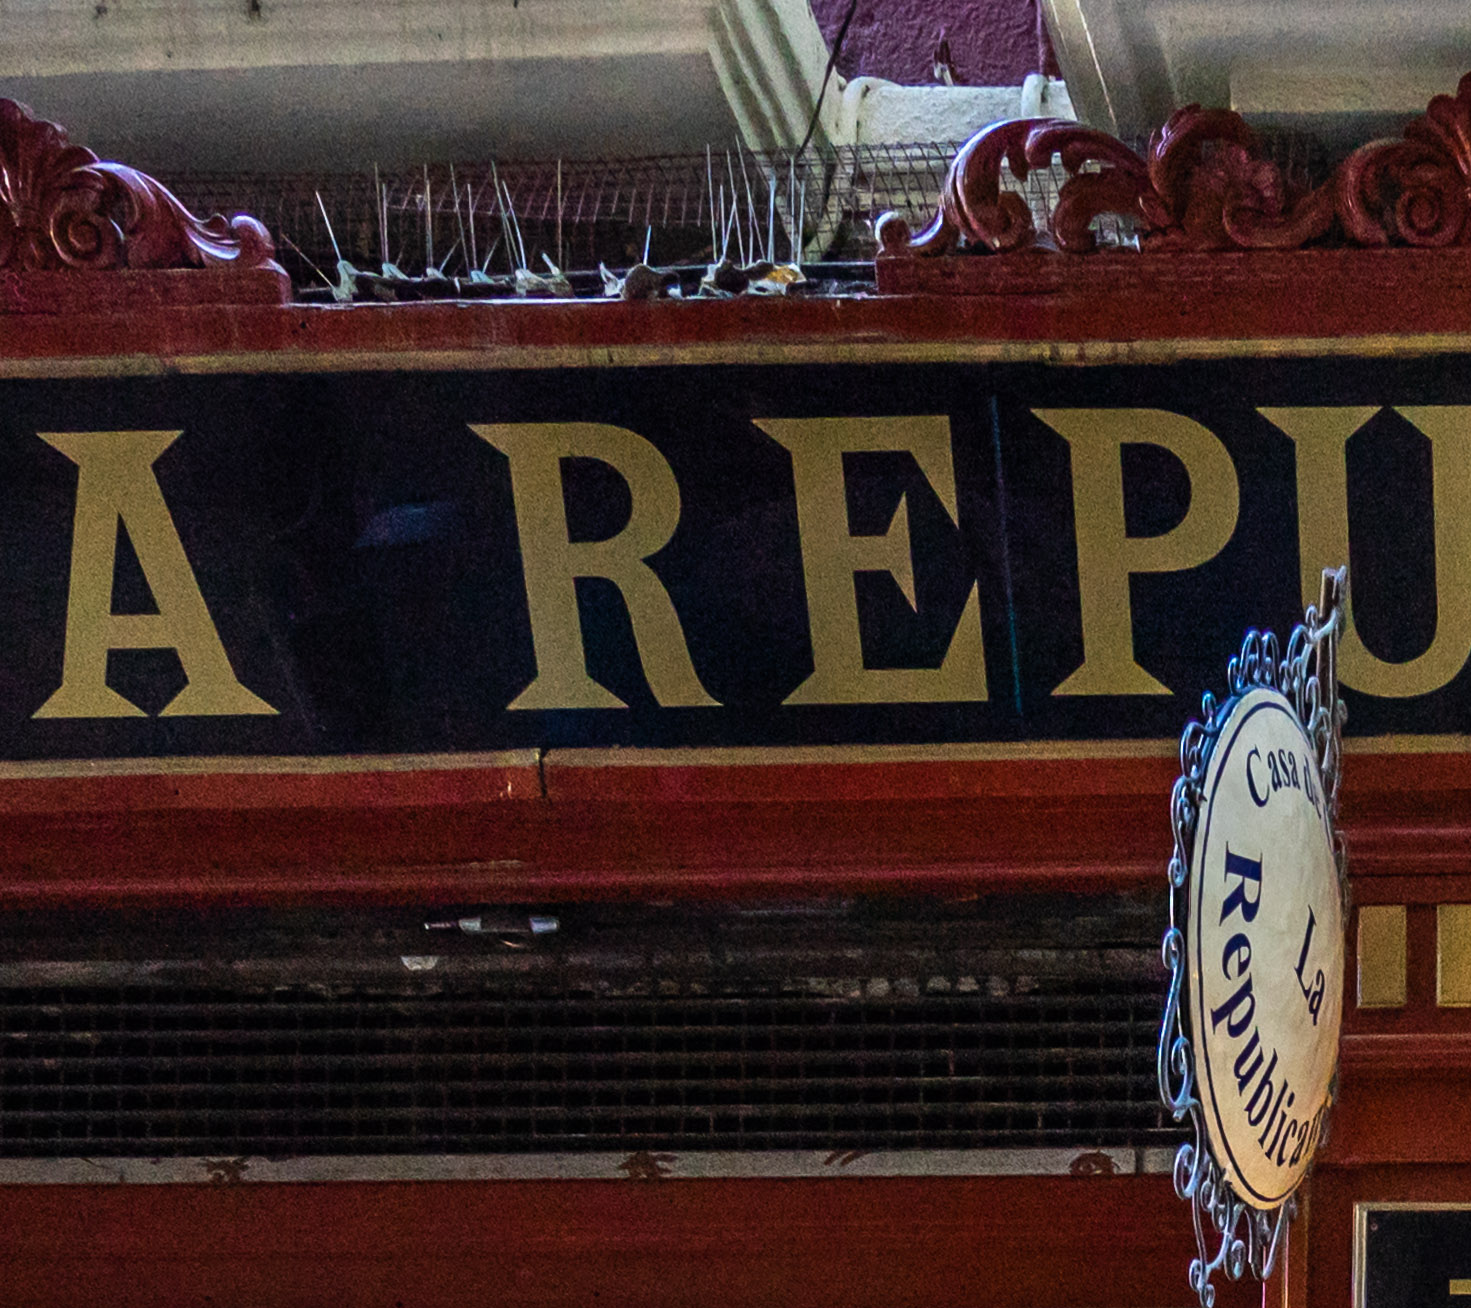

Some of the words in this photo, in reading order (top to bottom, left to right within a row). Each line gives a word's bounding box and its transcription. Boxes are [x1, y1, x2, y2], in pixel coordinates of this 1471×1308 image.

[1246, 746, 1301, 808] Casa
[1210, 841, 1330, 1172] Republican
[1294, 904, 1327, 1026] La
